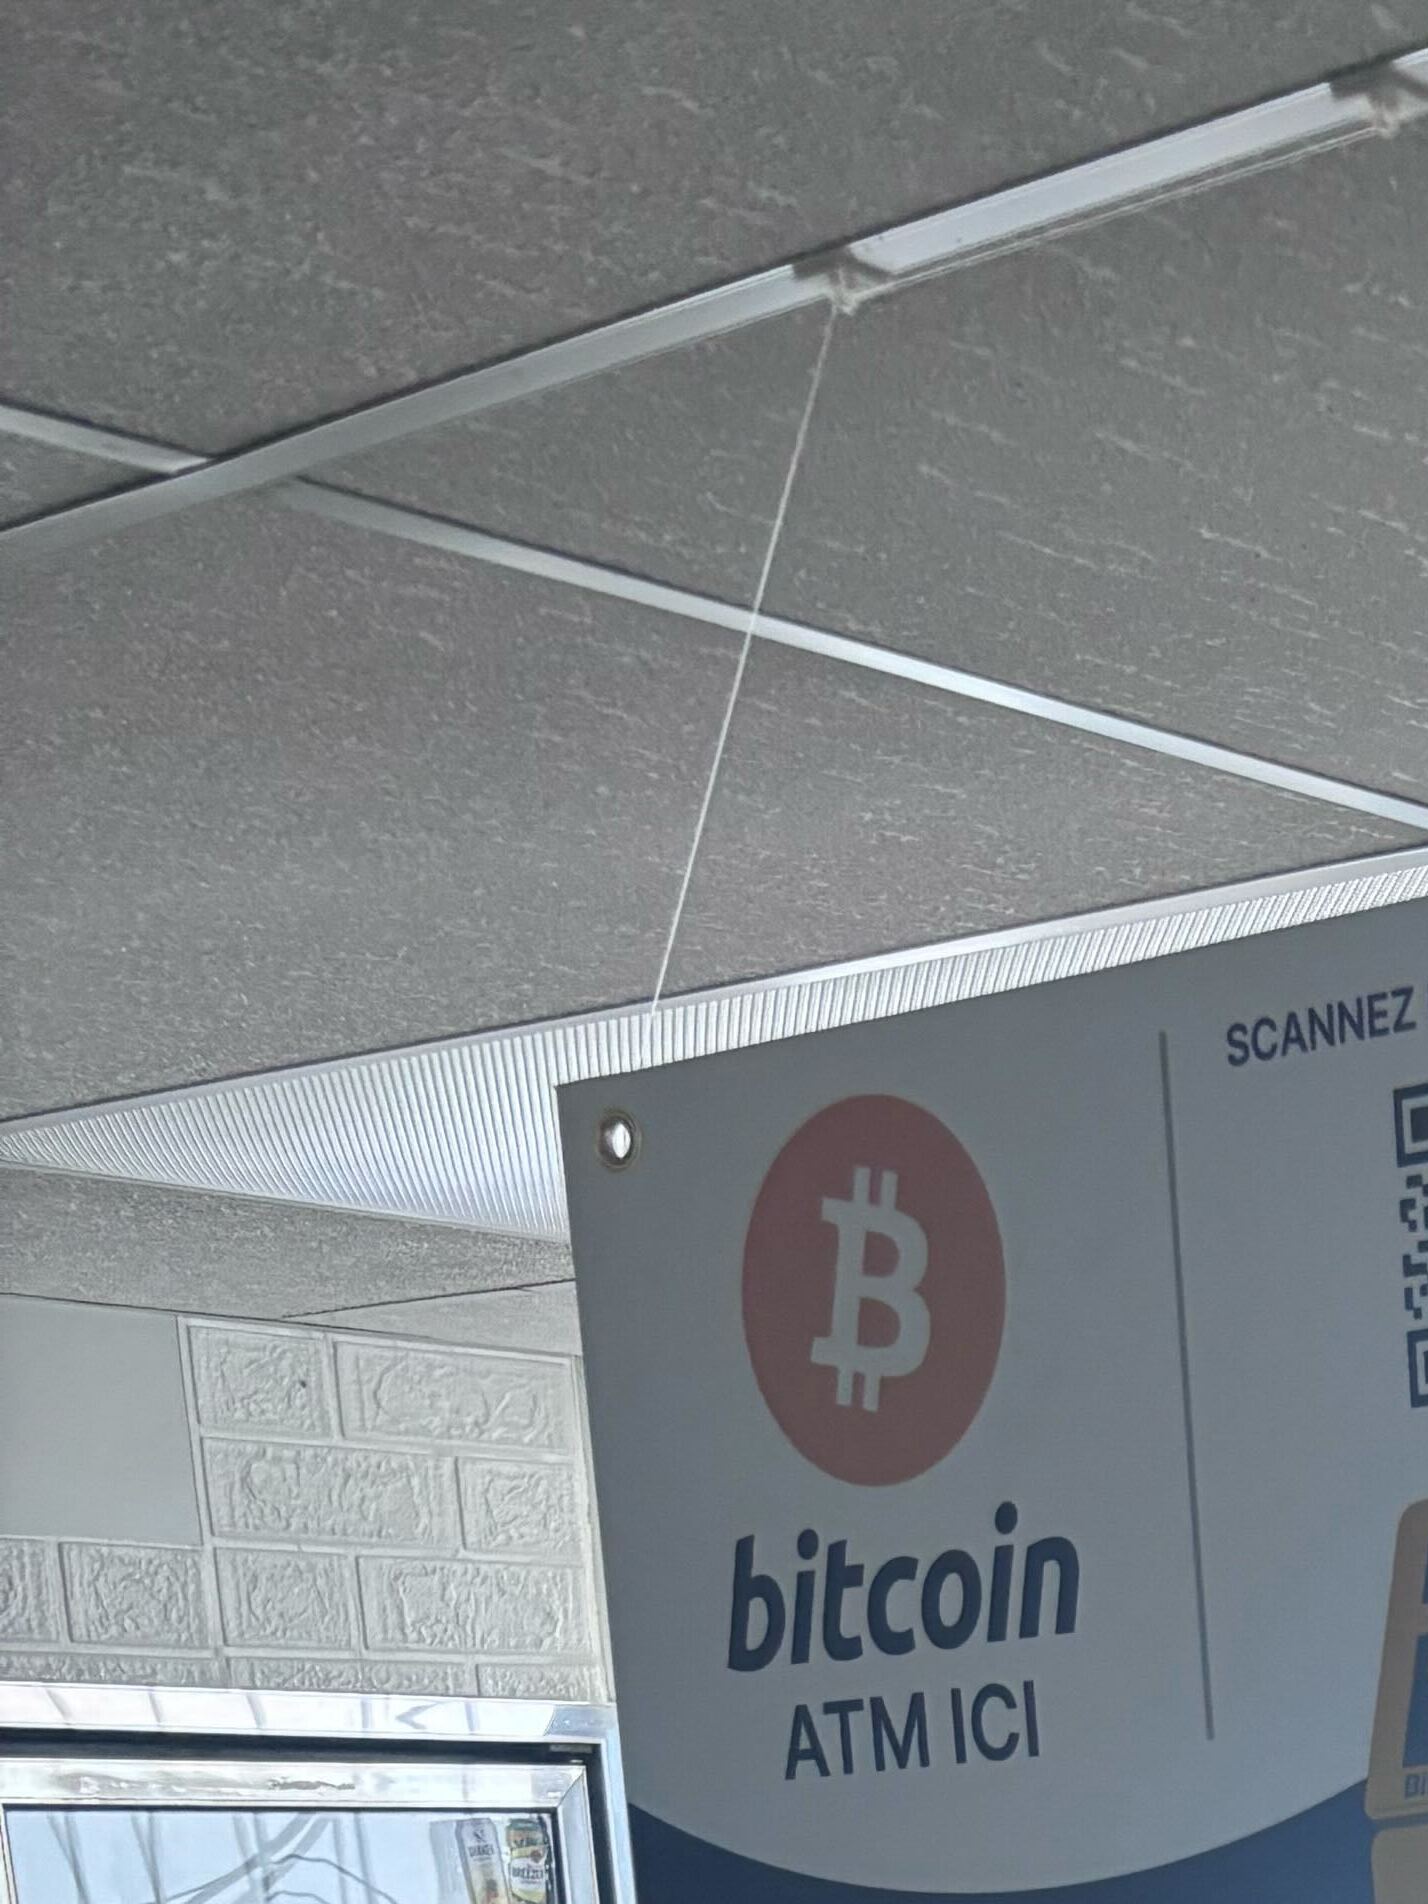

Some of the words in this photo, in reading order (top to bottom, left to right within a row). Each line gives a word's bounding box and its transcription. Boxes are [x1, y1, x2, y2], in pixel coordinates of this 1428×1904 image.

[1225, 988, 1415, 1066] SCANNEZ
[727, 1501, 1080, 1674] bitcoin
[785, 1691, 932, 1781] ATM
[952, 1680, 1041, 1764] ICI
